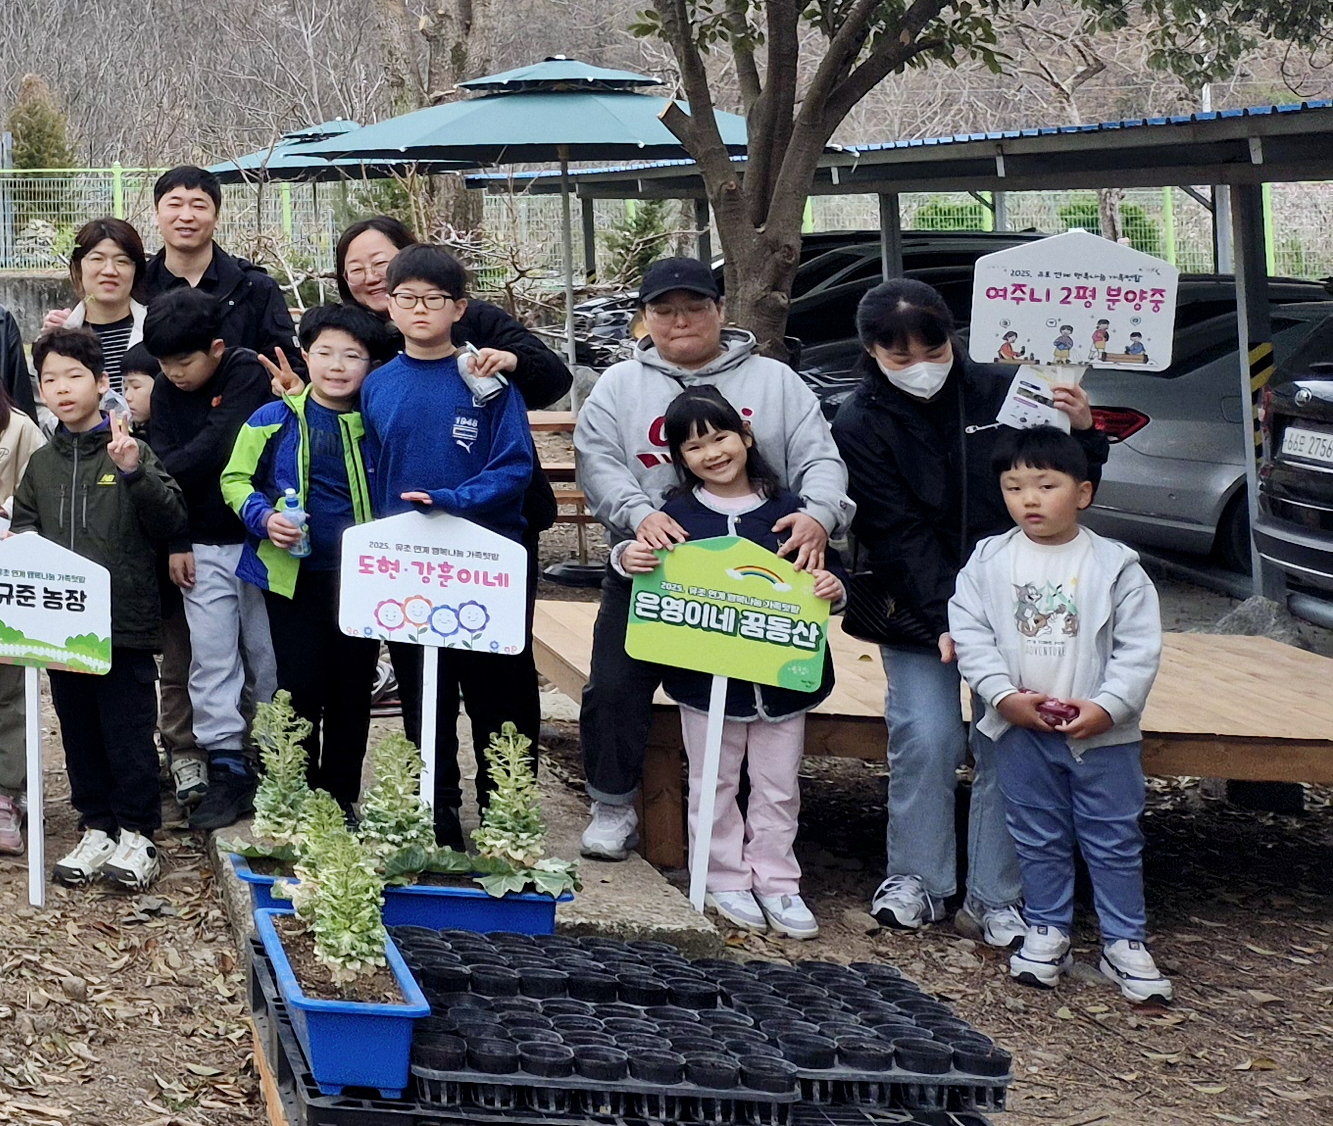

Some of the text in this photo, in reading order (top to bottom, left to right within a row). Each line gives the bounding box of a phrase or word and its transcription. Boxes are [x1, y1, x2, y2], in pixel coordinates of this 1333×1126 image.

[985, 283, 1166, 313] 여주니 2평 분양중
[455, 416, 478, 427] 1948
[42, 586, 87, 613] 농장
[635, 592, 821, 649] 은영이네 꿈동산
